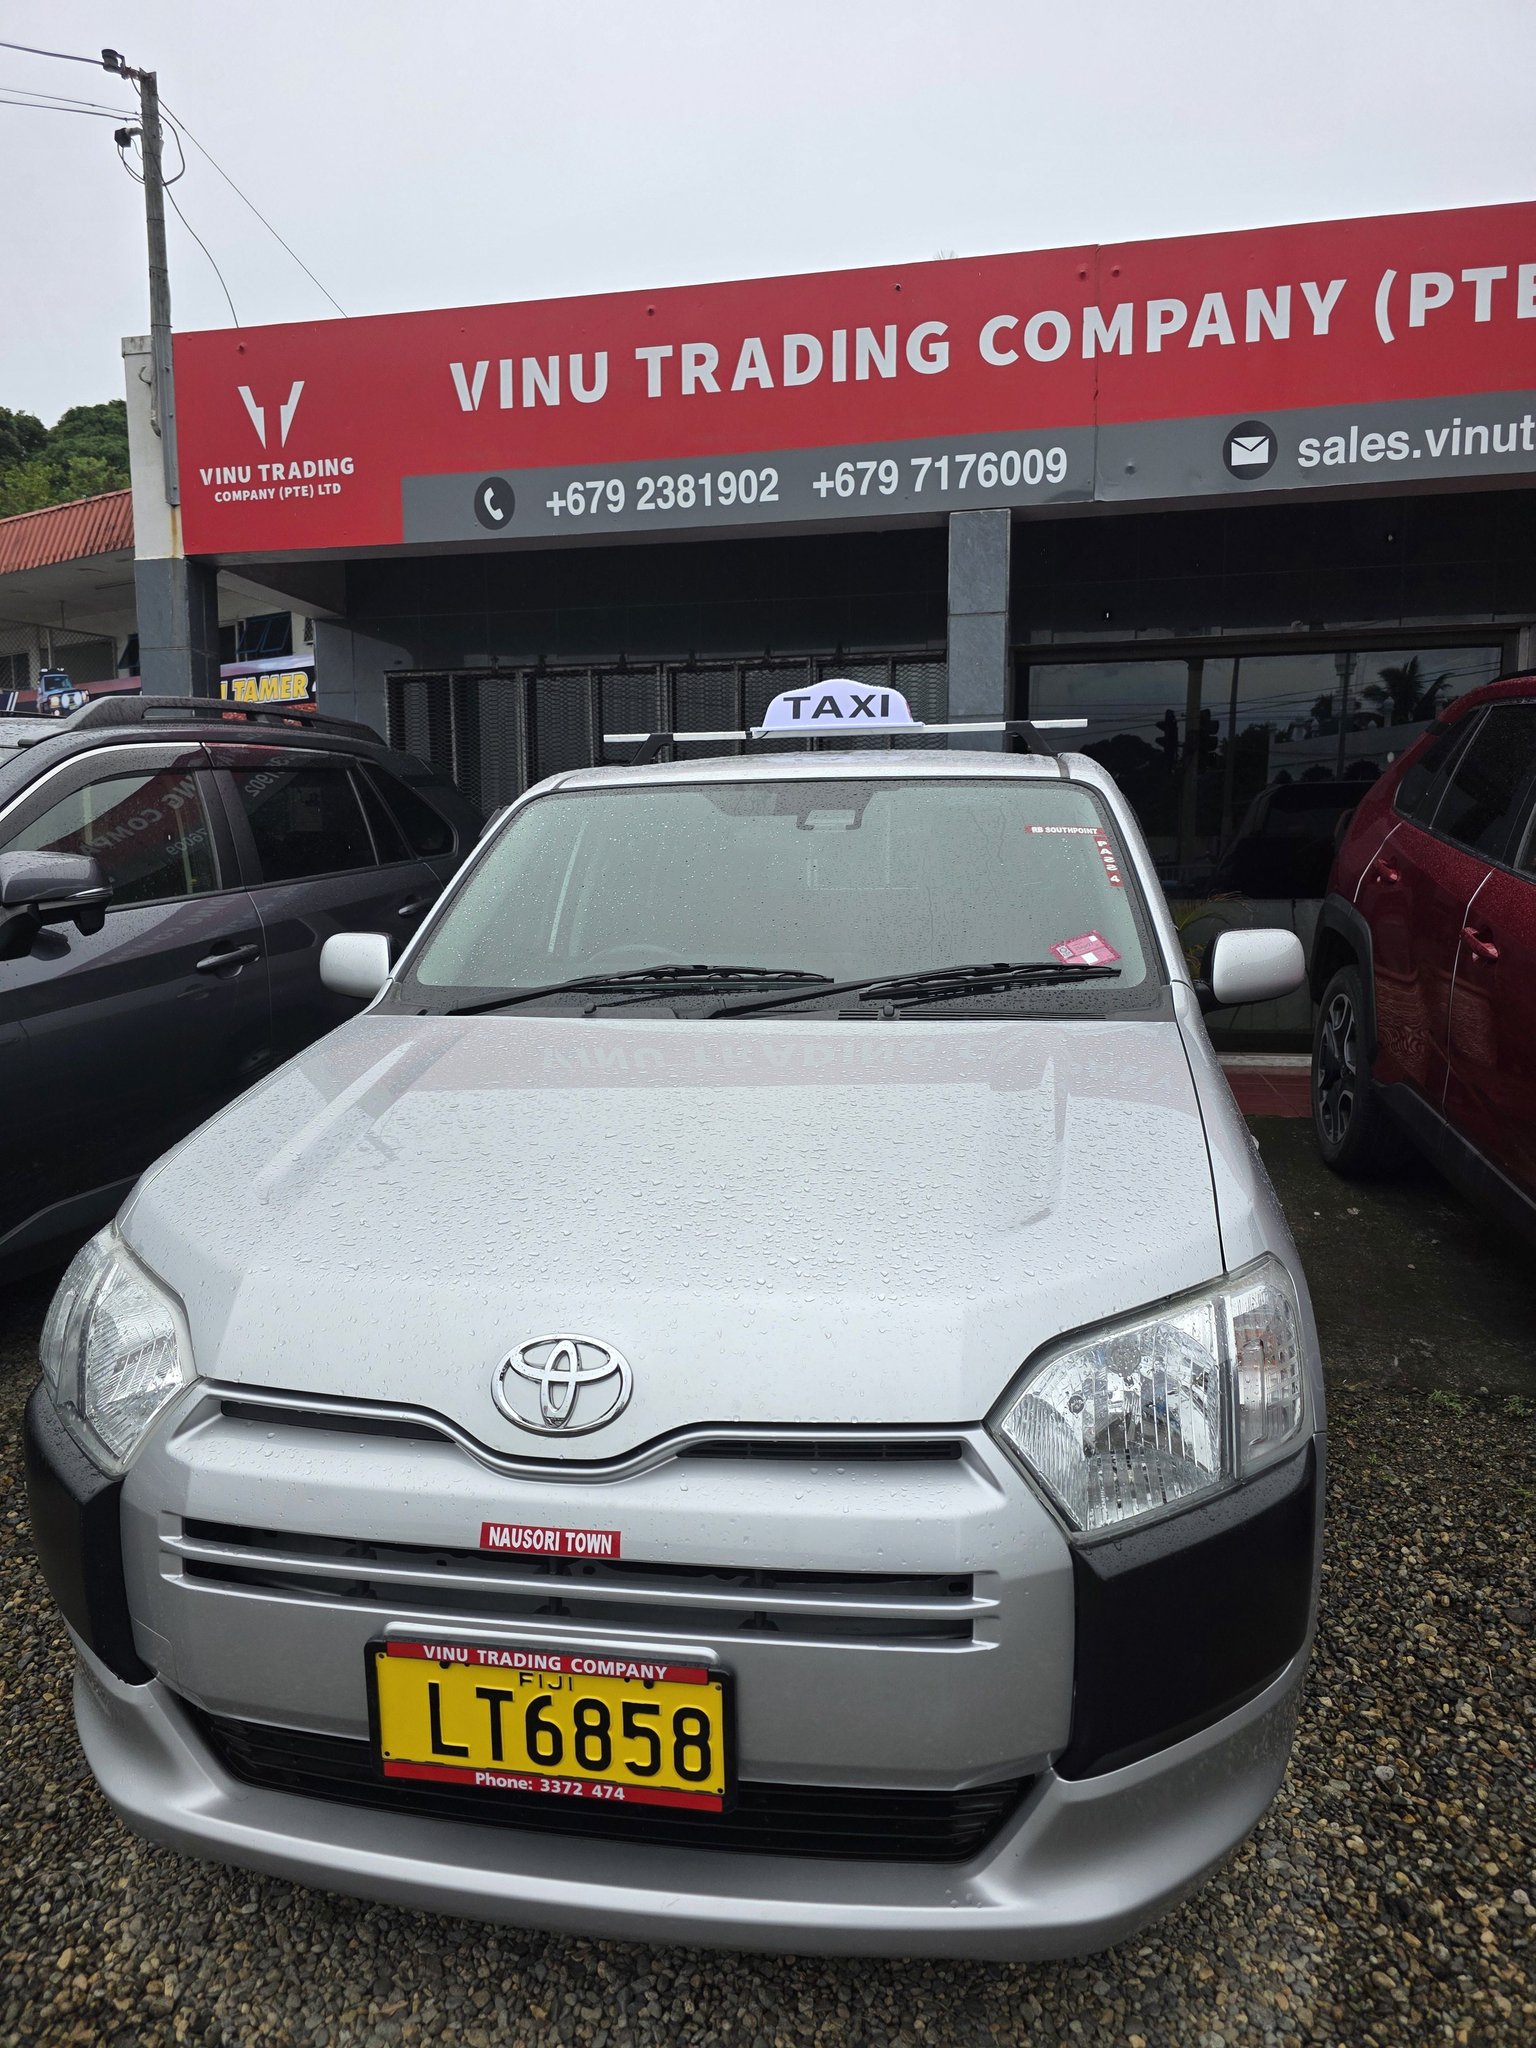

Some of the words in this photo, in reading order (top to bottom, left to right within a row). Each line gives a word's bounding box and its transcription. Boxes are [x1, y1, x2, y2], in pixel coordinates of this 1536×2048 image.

[450, 351, 608, 412] VINU
[635, 320, 949, 398] TRADING
[979, 279, 1347, 366] COMPANY
[1297, 415, 1535, 468] sales.vinut
[200, 465, 251, 486] VINU
[257, 456, 355, 482] TRADING
[812, 459, 899, 498] +679
[910, 447, 1067, 493] 7176009
[214, 487, 276, 503] COMPANY
[279, 483, 315, 501] (PTE)
[318, 482, 342, 496] LTD
[546, 479, 626, 517] +679
[636, 467, 780, 511] 2381902
[232, 671, 309, 703] TAMER
[783, 694, 890, 720] TAXI
[1045, 826, 1098, 835] SOUTHPOINT
[489, 1526, 560, 1551] NAUSORI
[565, 1532, 612, 1555] TOWN
[423, 1645, 468, 1662] VINU
[477, 1650, 561, 1671] TRADING
[571, 1658, 668, 1680] COMPANY
[518, 1671, 574, 1691] FIJI
[427, 1681, 713, 1782] LT6858
[475, 1772, 533, 1791] Phone:
[540, 1778, 584, 1796] 3372
[591, 1785, 625, 1801] 474
